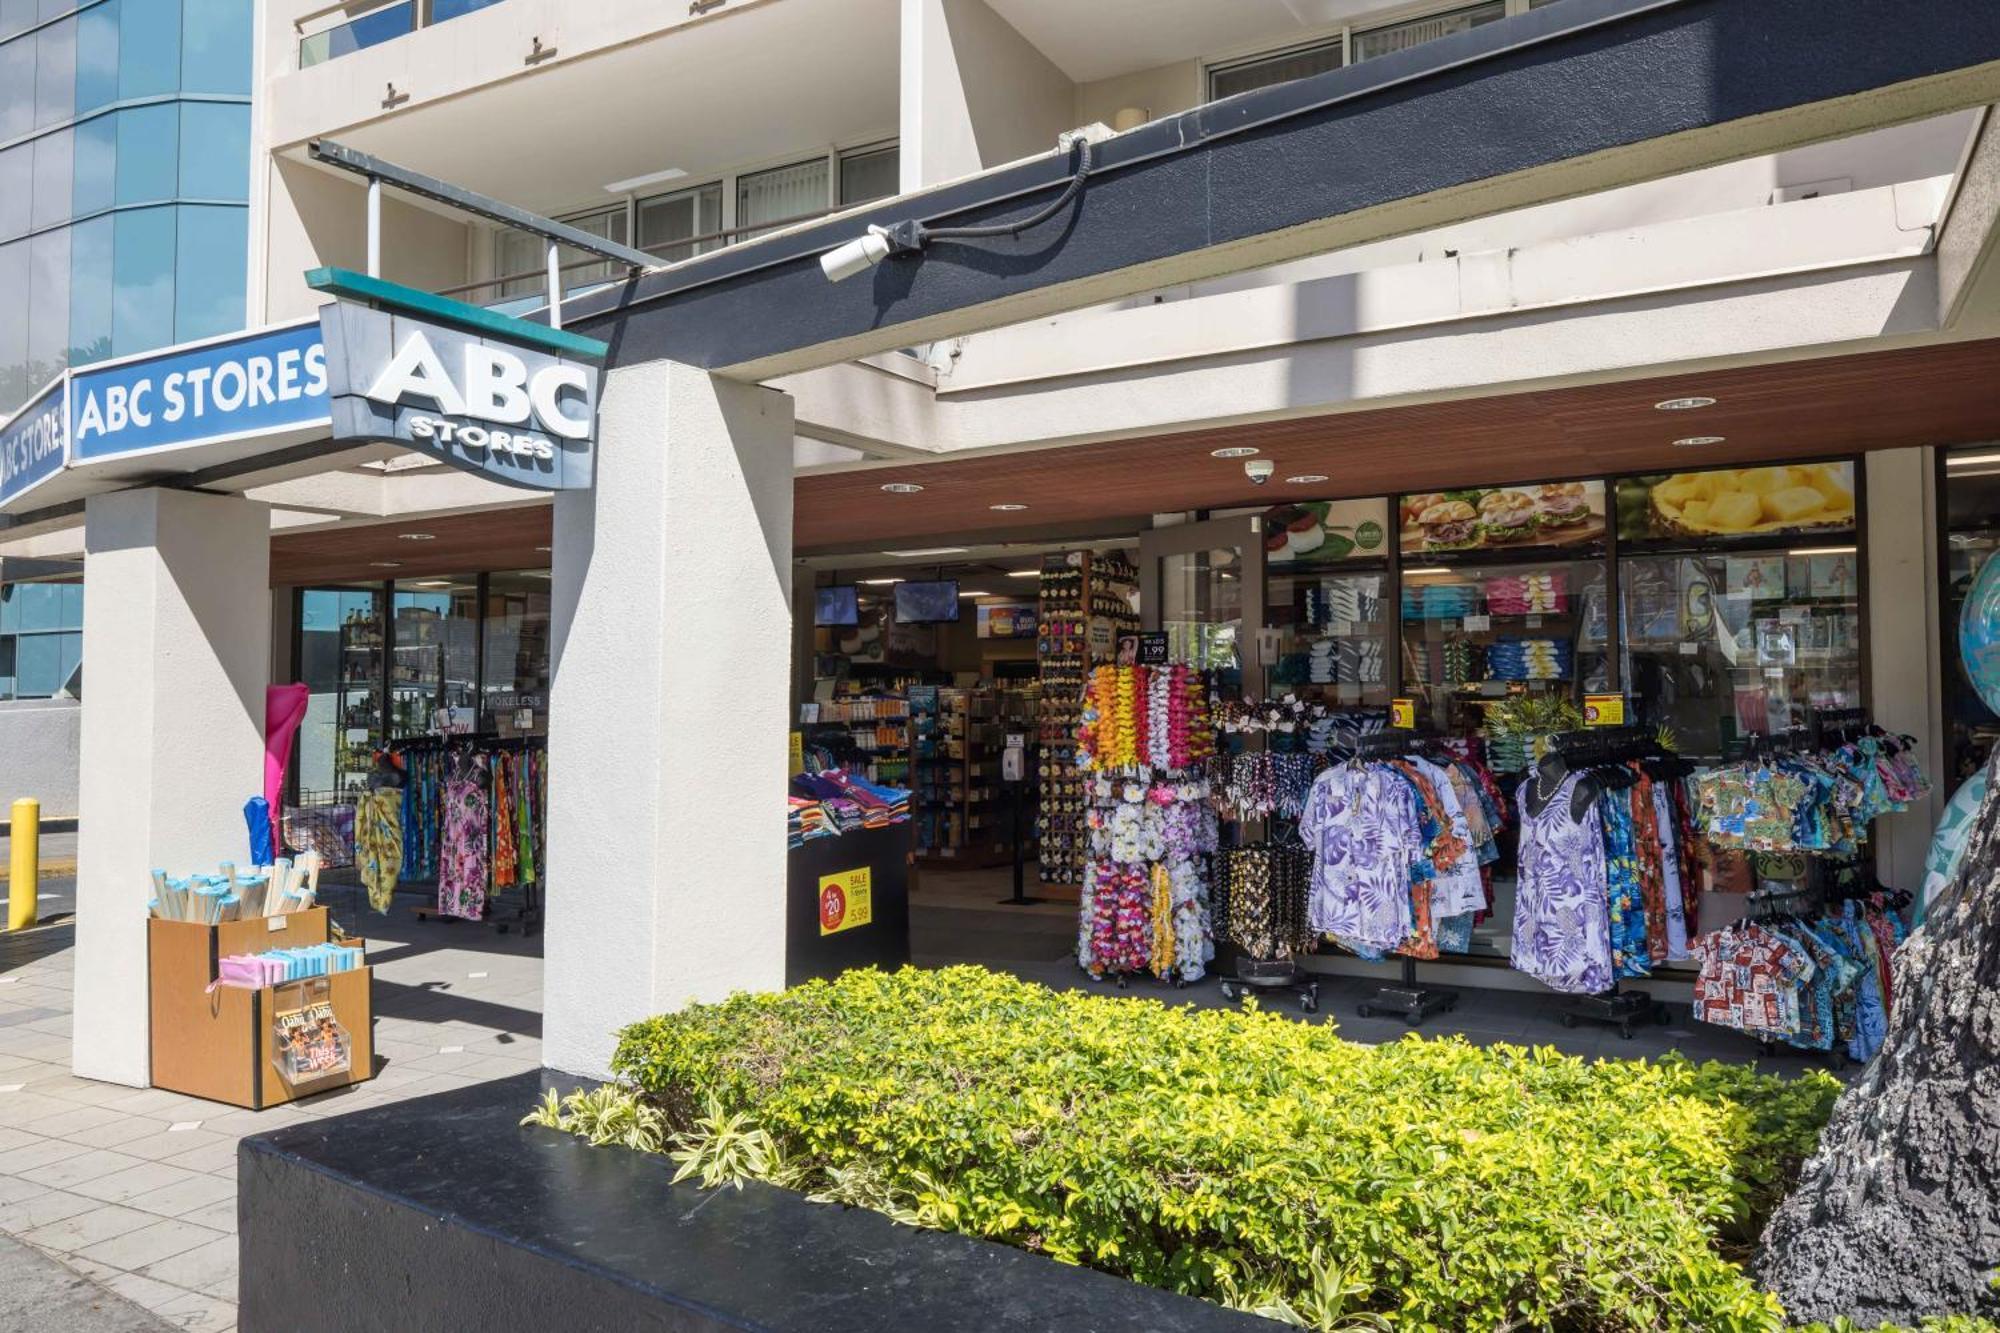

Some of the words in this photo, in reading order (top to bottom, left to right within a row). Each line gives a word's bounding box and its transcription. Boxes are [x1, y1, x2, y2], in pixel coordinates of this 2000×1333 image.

[77, 378, 152, 440] ABC
[163, 343, 329, 423] STORES
[366, 330, 590, 439] ABC
[409, 416, 554, 460] STORES
[1143, 645, 1166, 656] 1.99
[486, 695, 541, 706] MOKELESS
[850, 873, 867, 886] SALE
